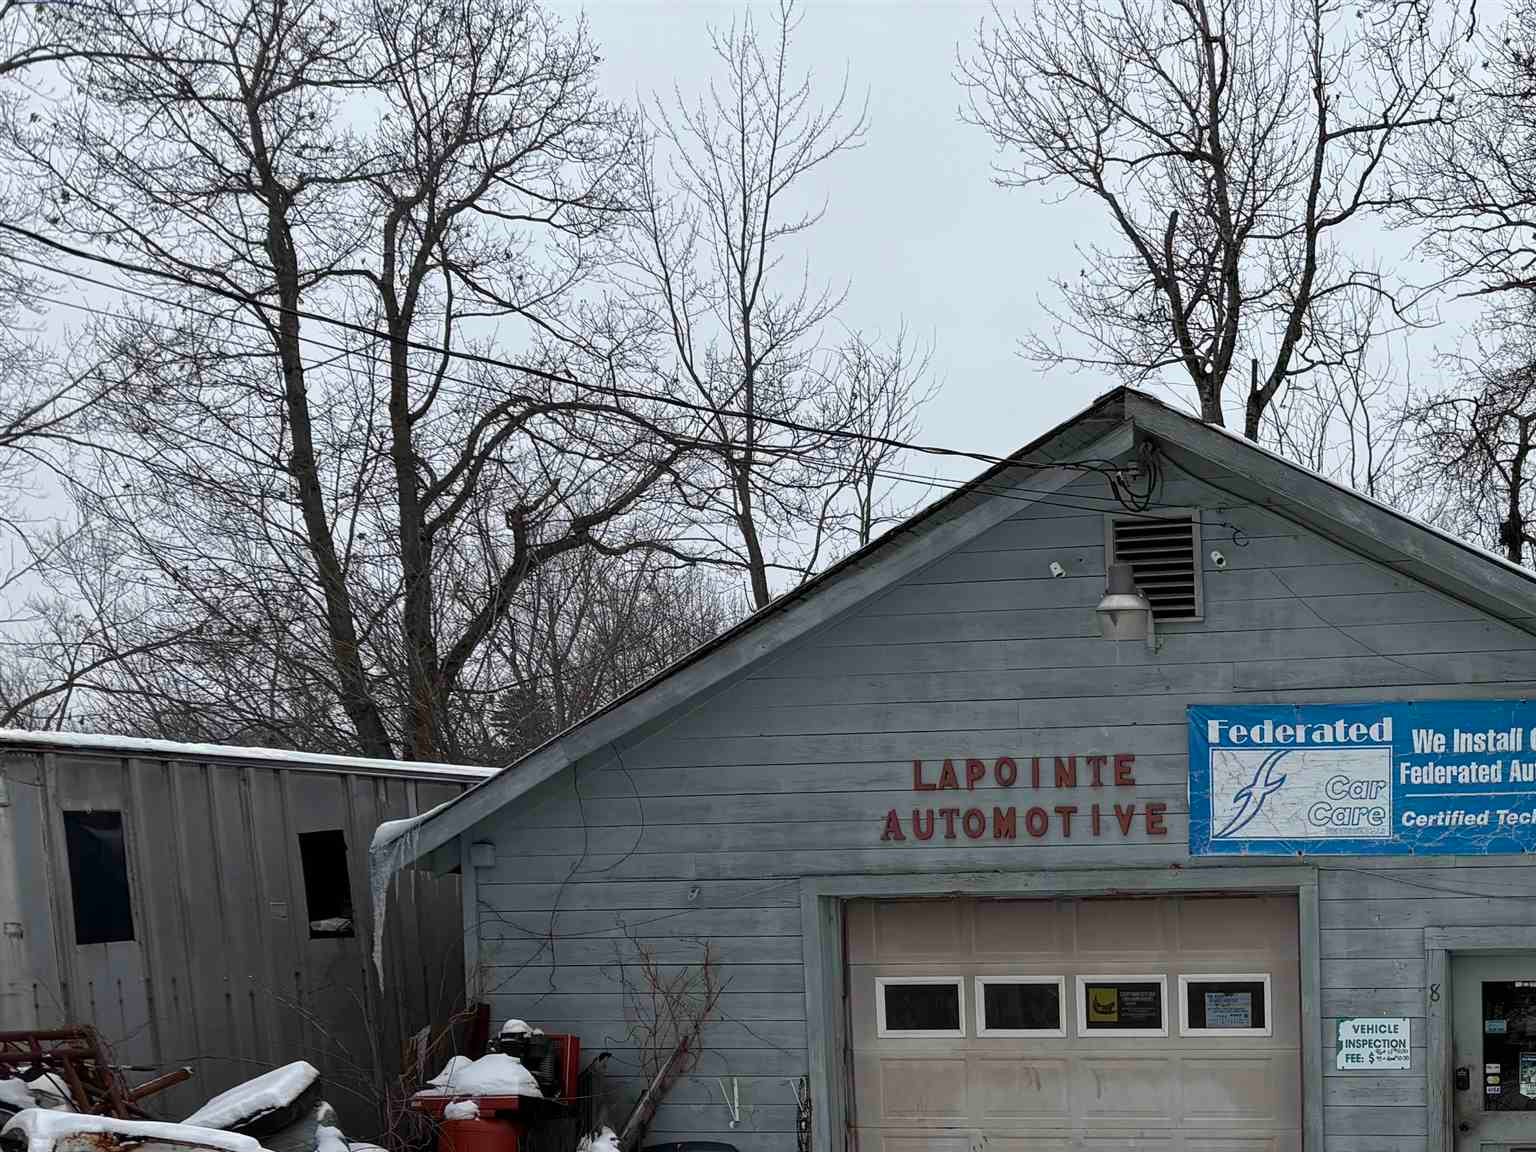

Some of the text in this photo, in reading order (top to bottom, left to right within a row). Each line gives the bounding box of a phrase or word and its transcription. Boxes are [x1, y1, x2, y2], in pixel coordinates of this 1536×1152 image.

[1207, 717, 1392, 744] Federated
[1411, 729, 1446, 754] We
[1453, 727, 1523, 753] Install
[912, 754, 1136, 791] LAPOINTE
[1400, 760, 1502, 785] Federated
[1325, 775, 1386, 800] Car
[879, 803, 1168, 841] AUTOMOTIVE
[1307, 801, 1386, 827] Care
[1402, 810, 1489, 827] Certified
[1352, 1024, 1400, 1034] VEHICLE
[1345, 1039, 1407, 1049] INSPECTION
[1344, 1053, 1365, 1063] FEE:
